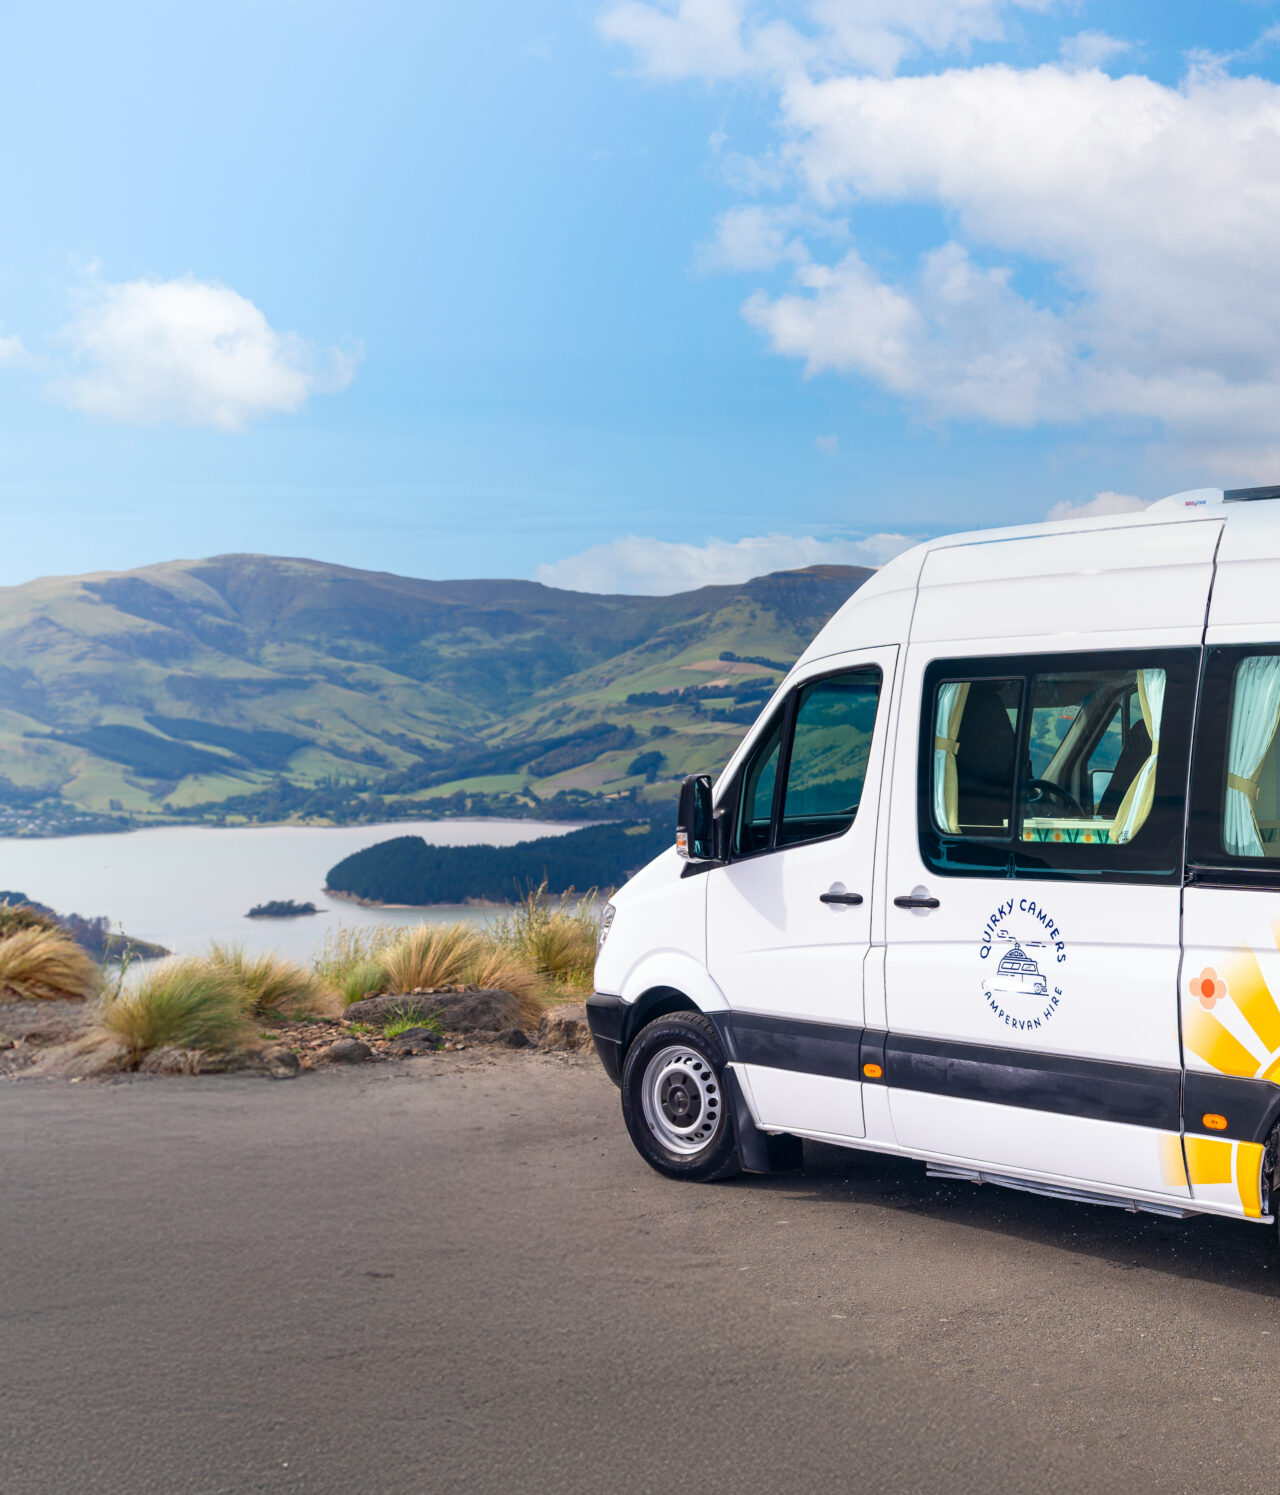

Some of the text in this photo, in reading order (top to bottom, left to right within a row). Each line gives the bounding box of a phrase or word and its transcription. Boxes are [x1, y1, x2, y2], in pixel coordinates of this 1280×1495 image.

[980, 899, 1066, 963] QUIRKY CAMPERS
[1043, 986, 1063, 1020] HIRE
